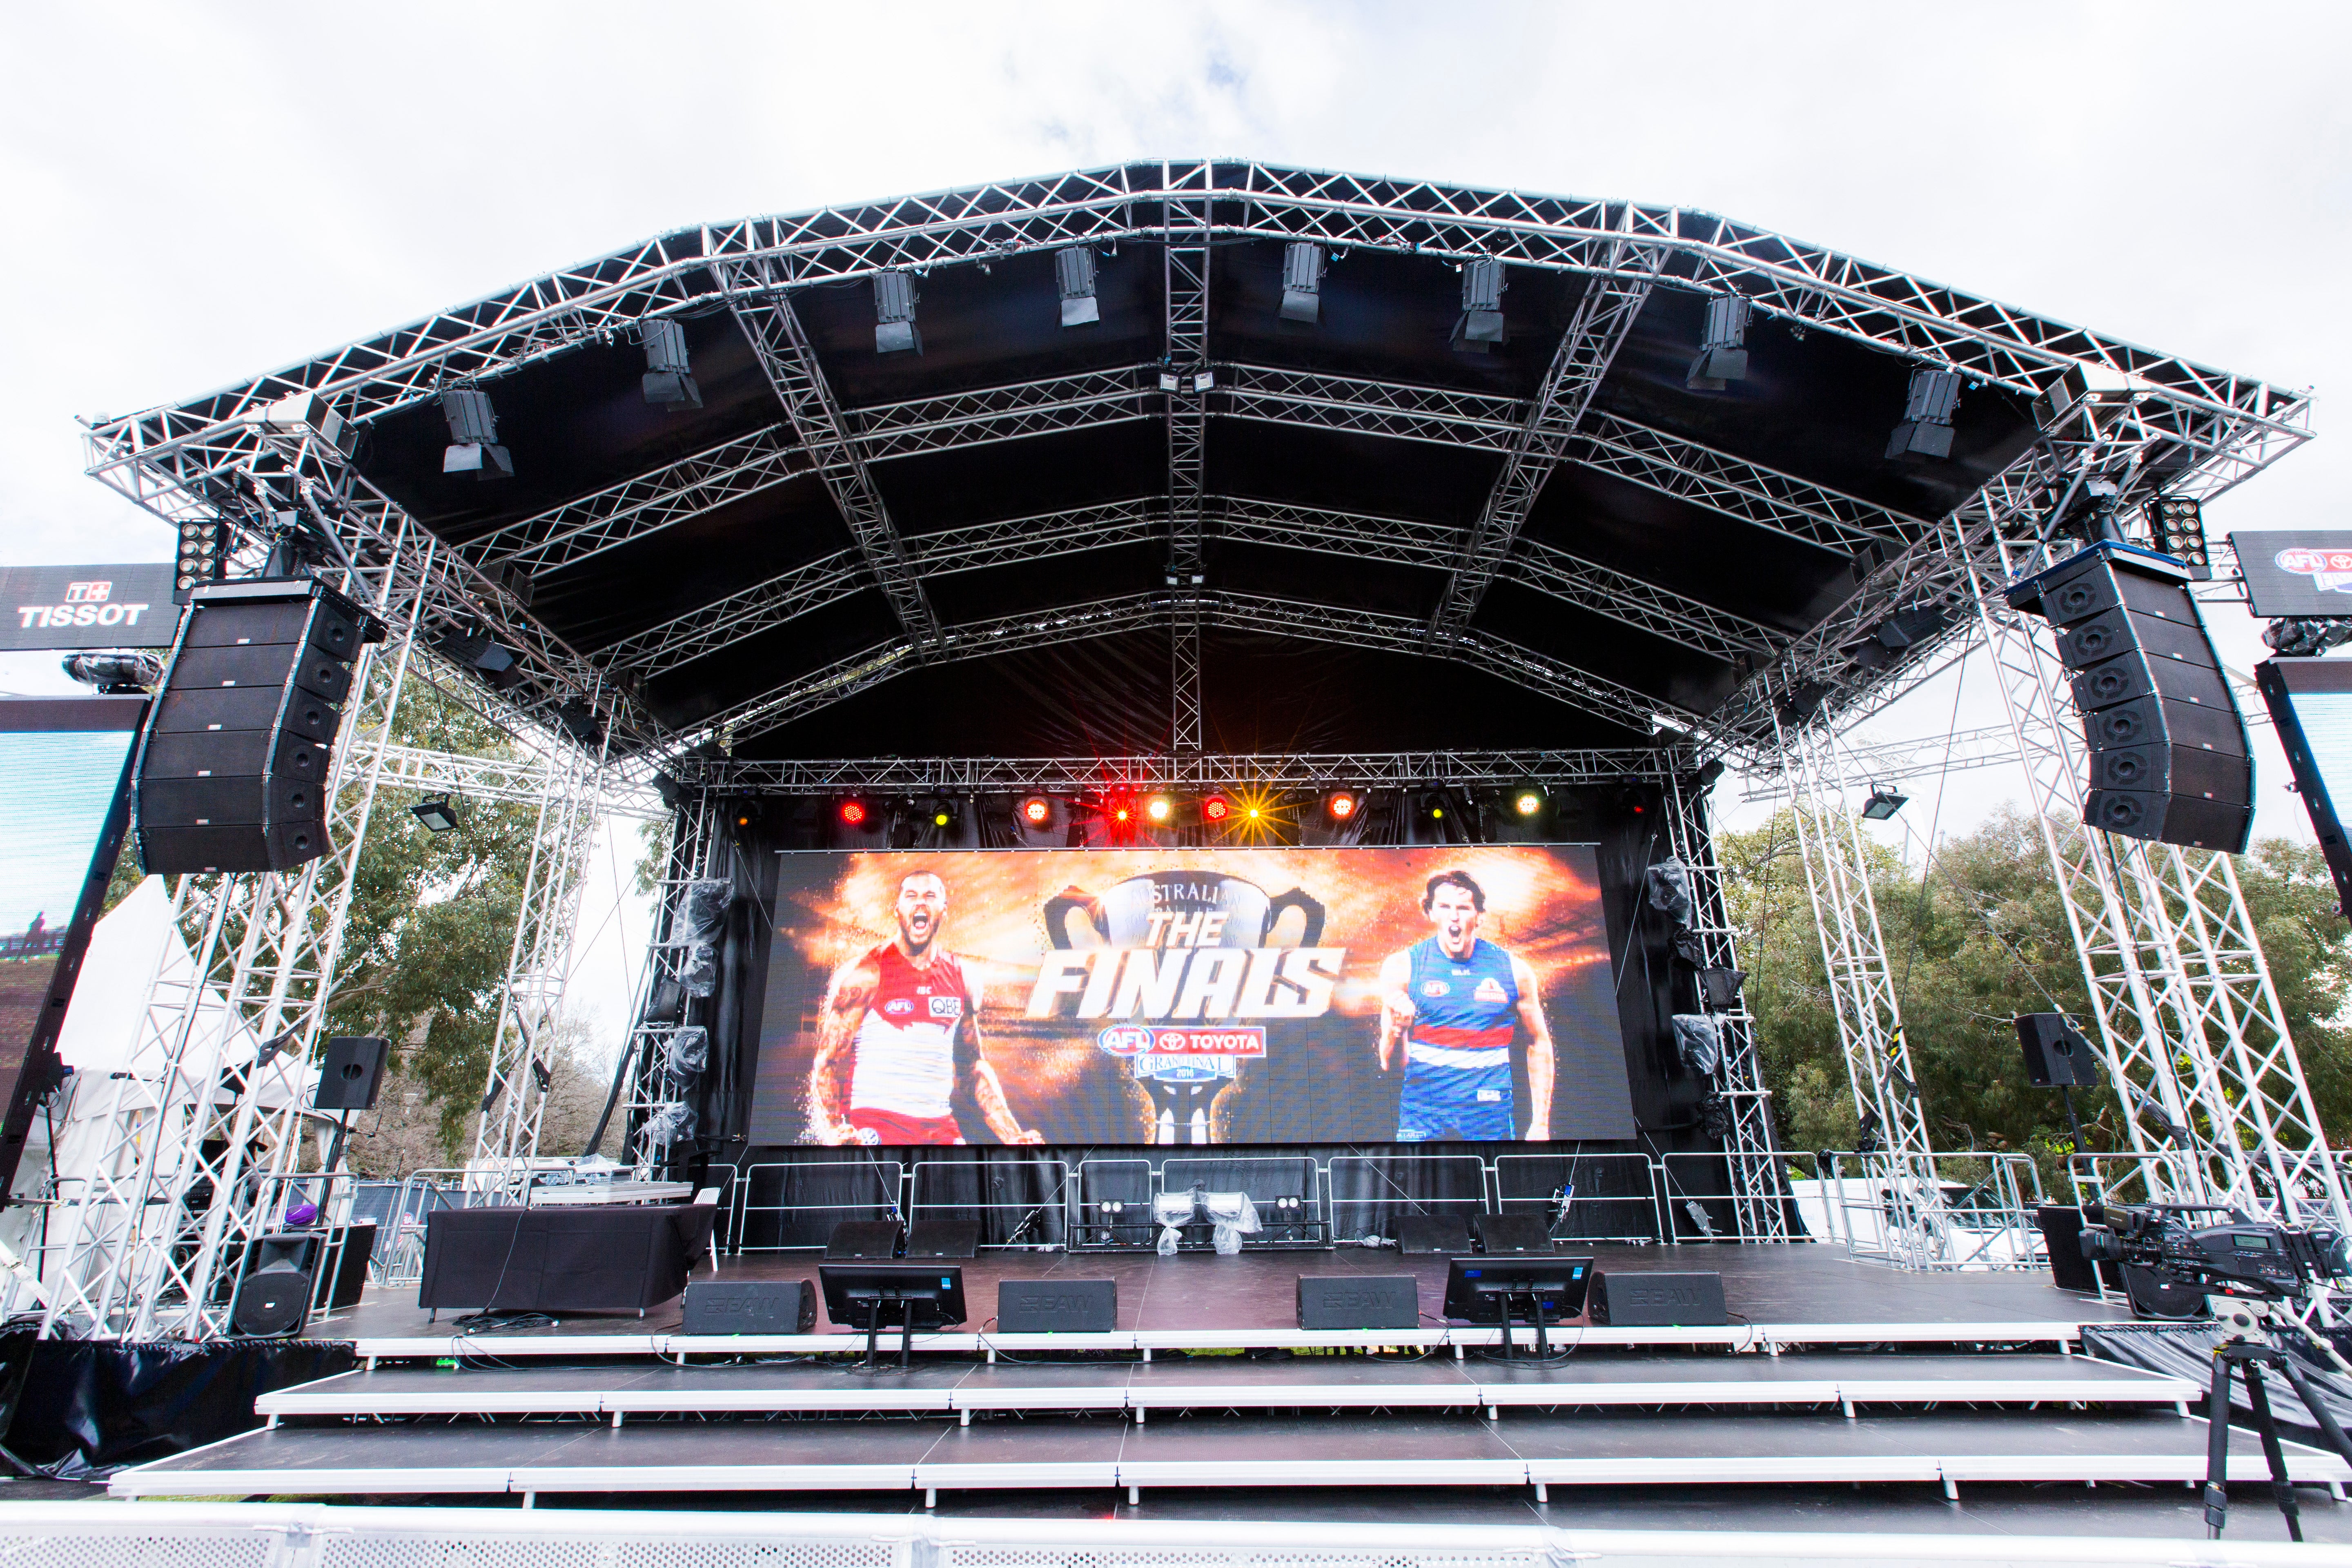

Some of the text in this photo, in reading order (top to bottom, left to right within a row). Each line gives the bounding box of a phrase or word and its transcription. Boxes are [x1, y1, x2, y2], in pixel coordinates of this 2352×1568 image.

[2283, 554, 2323, 568] AFL
[18, 604, 150, 628] TISSOT
[1146, 911, 1229, 947] THE
[1026, 947, 1347, 1018] FINALS
[887, 1002, 911, 1012] AFL
[932, 998, 960, 1015] QBE
[1103, 1031, 1150, 1049] AFL
[1190, 1035, 1259, 1049] TOYOTA
[1139, 1056, 1231, 1072] GRAND FINAL
[1040, 1295, 1094, 1312] EAW
[1344, 1291, 1396, 1309] EAW
